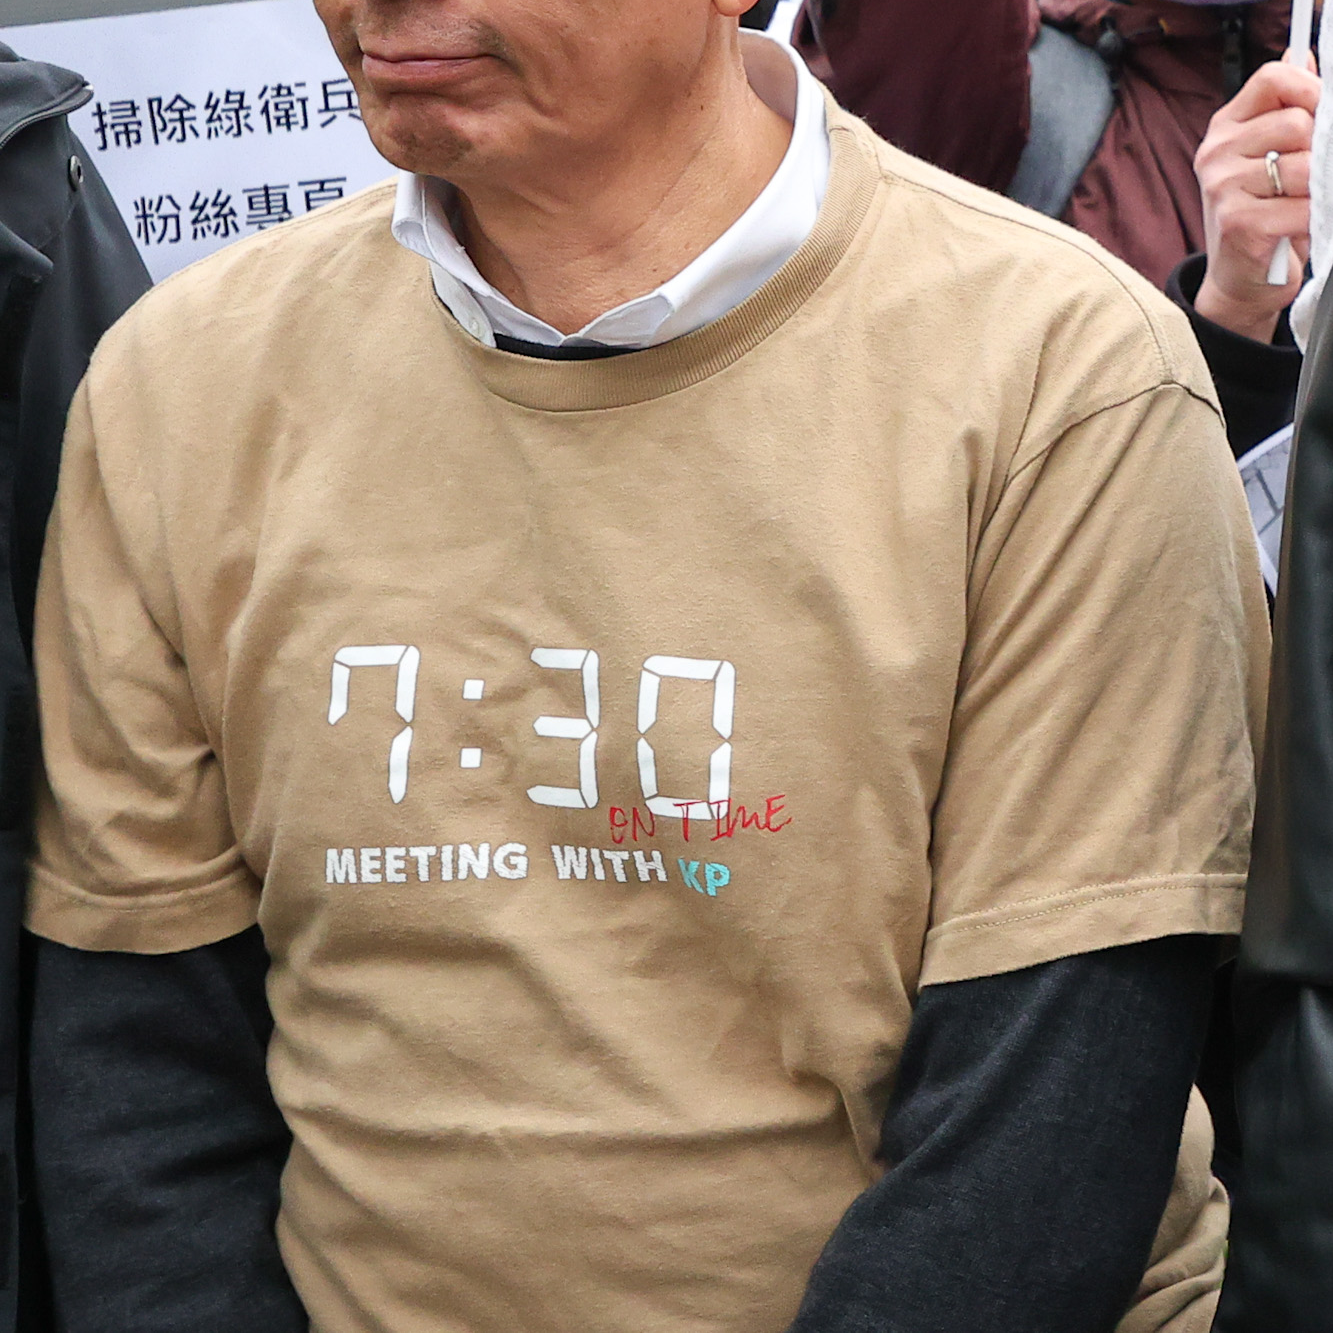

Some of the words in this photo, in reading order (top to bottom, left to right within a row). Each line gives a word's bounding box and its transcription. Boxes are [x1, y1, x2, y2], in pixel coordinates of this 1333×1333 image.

[92, 77, 363, 151] 掃除綠衛兵
[326, 644, 737, 821] 7:30
[325, 841, 529, 885] MEETING
[550, 843, 668, 883] WITH
[676, 856, 732, 897] KP
